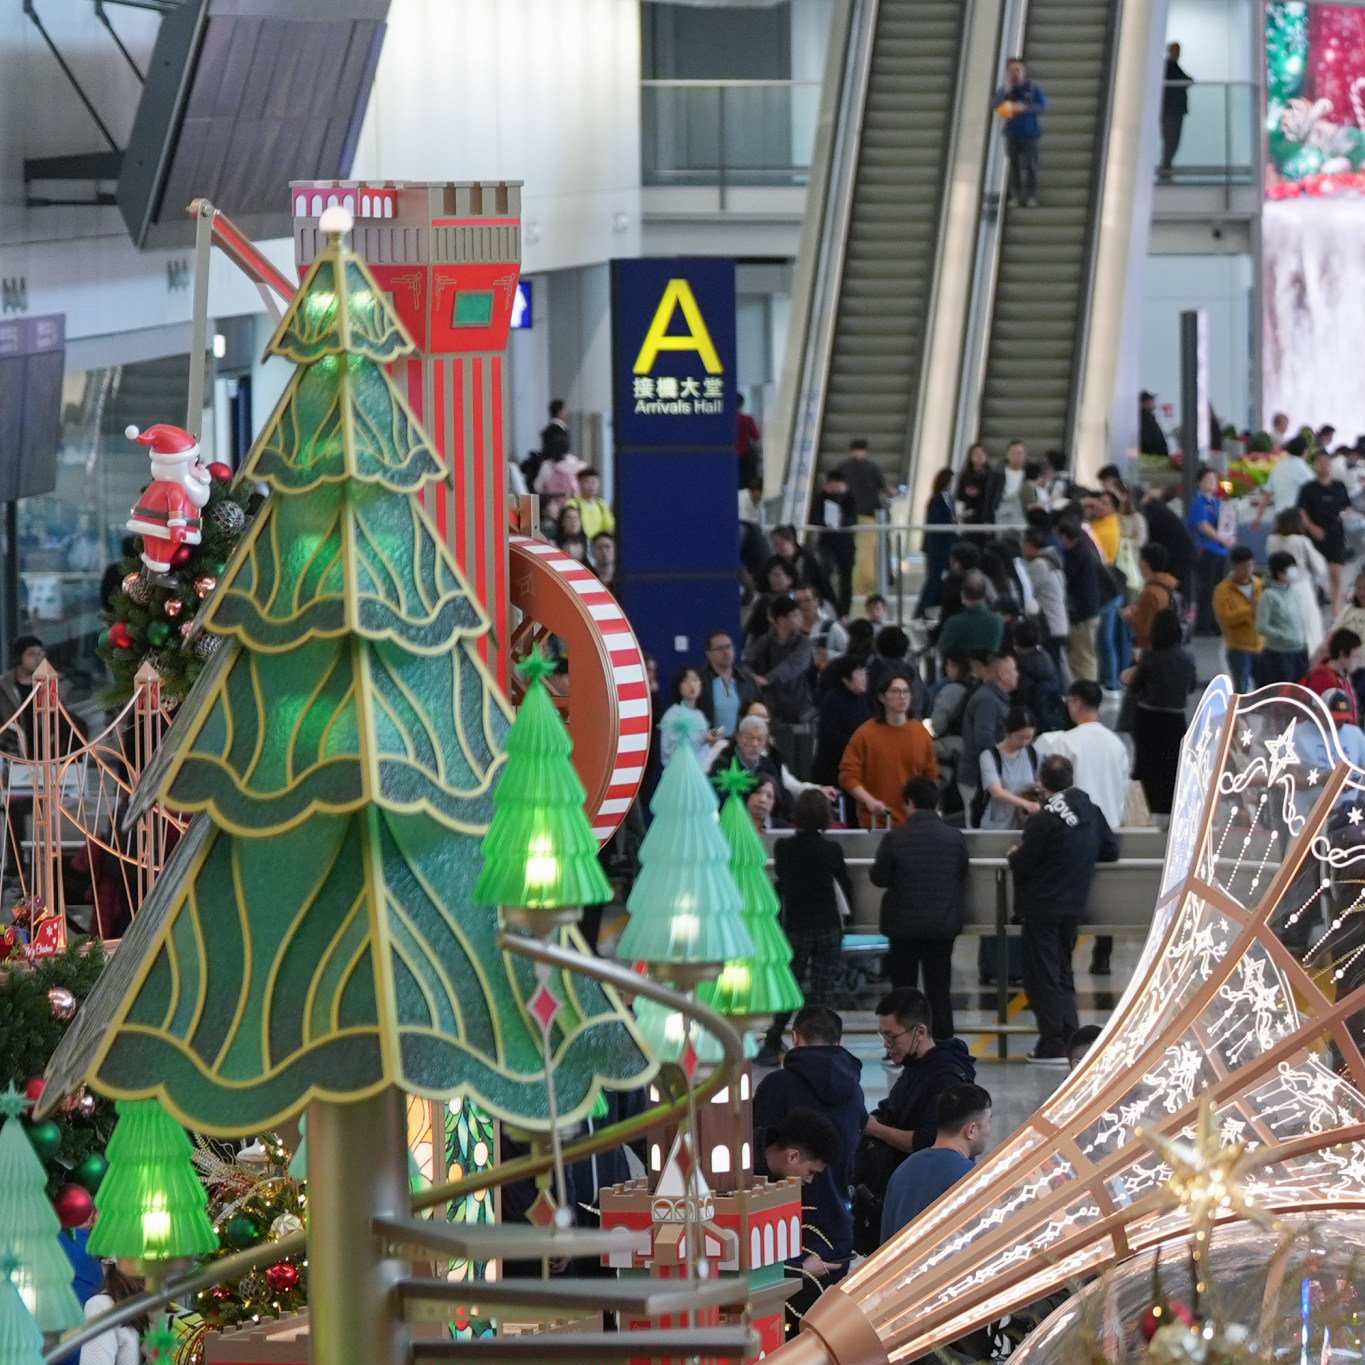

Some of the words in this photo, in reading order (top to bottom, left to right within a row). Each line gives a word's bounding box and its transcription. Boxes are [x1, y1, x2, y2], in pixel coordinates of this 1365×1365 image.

[633, 279, 724, 374] A
[633, 377, 724, 399] 接機大堂
[635, 399, 692, 415] Arrivals
[694, 400, 724, 415] Hall
